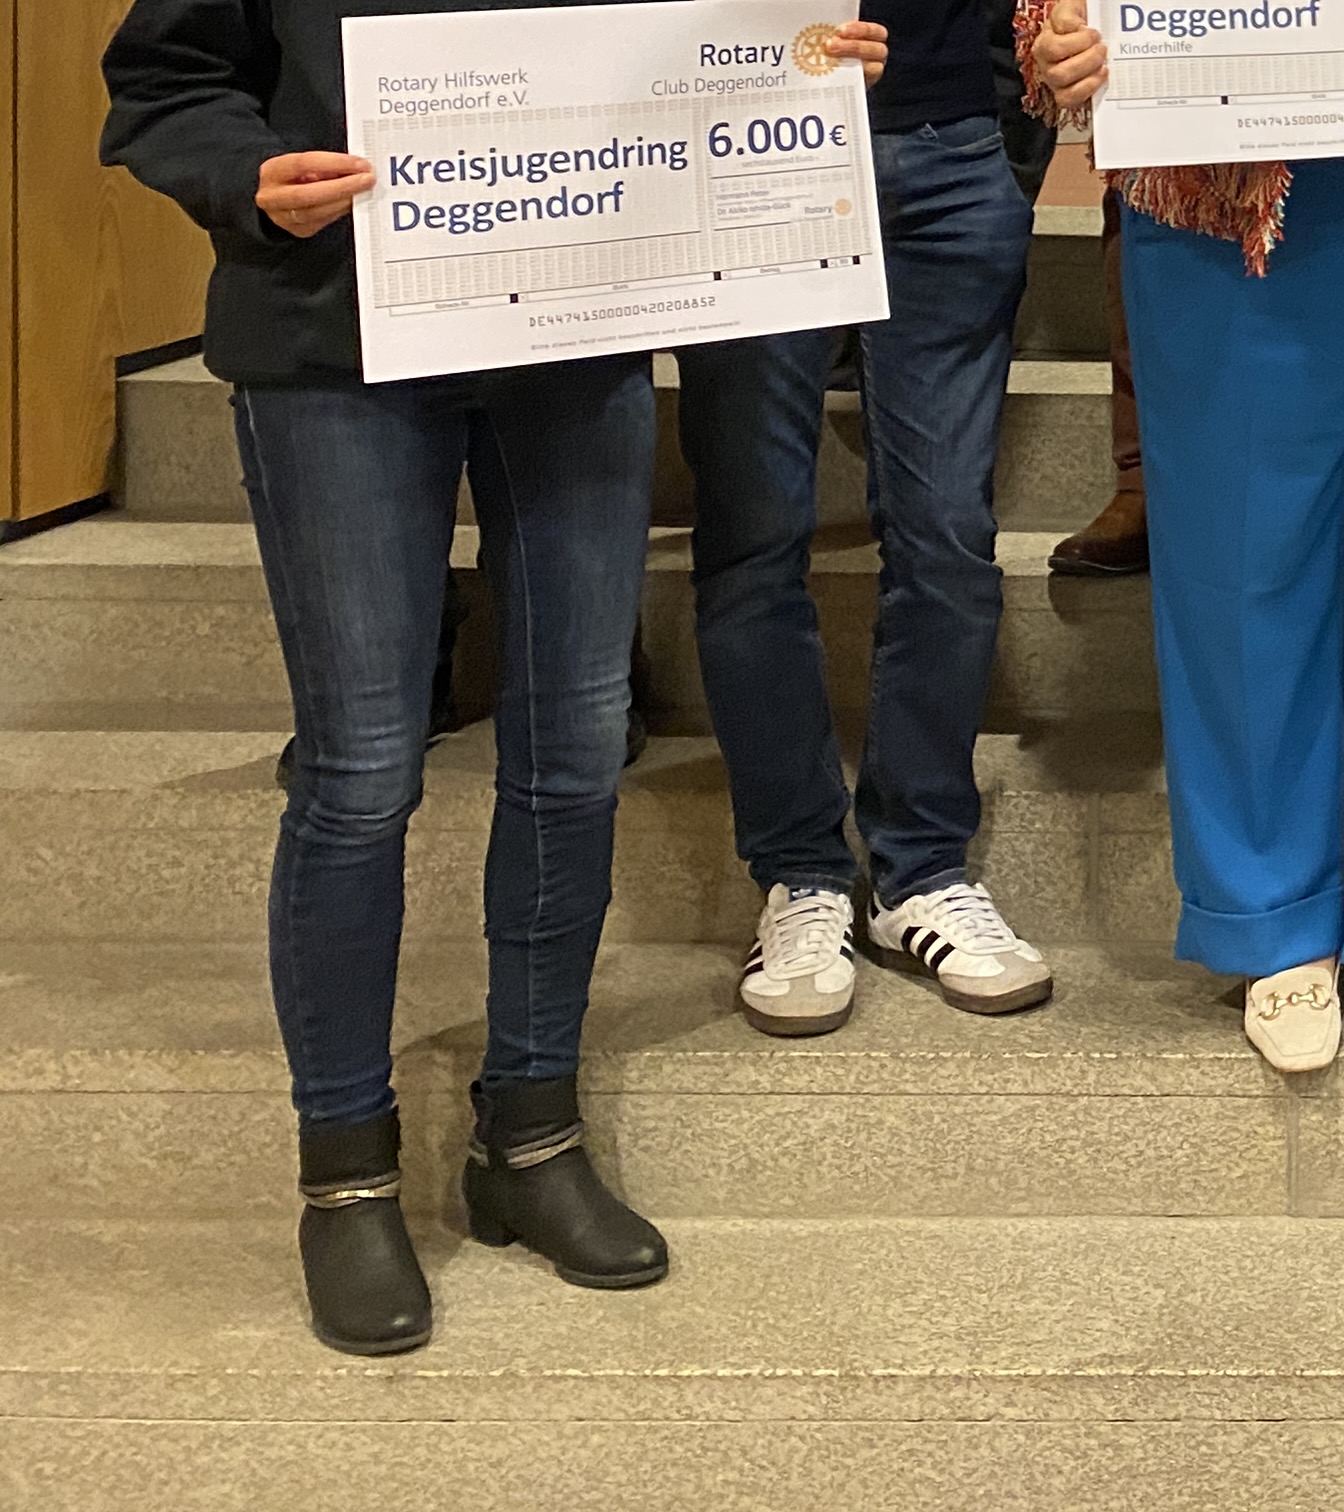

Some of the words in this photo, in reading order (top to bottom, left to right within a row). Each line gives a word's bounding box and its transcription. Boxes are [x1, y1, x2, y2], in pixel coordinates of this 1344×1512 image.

[699, 42, 785, 68] Rotary
[1119, 40, 1193, 55] Kinderhilfe
[377, 74, 438, 95] Rotary
[445, 67, 528, 88] Hilfswerk
[651, 78, 689, 97] Club
[694, 70, 787, 95] Deggendorf
[378, 91, 490, 116] Deggendorf
[496, 90, 530, 108] e.V.
[389, 135, 688, 186] Kreisjugendring
[391, 180, 625, 235] Deggendorf
